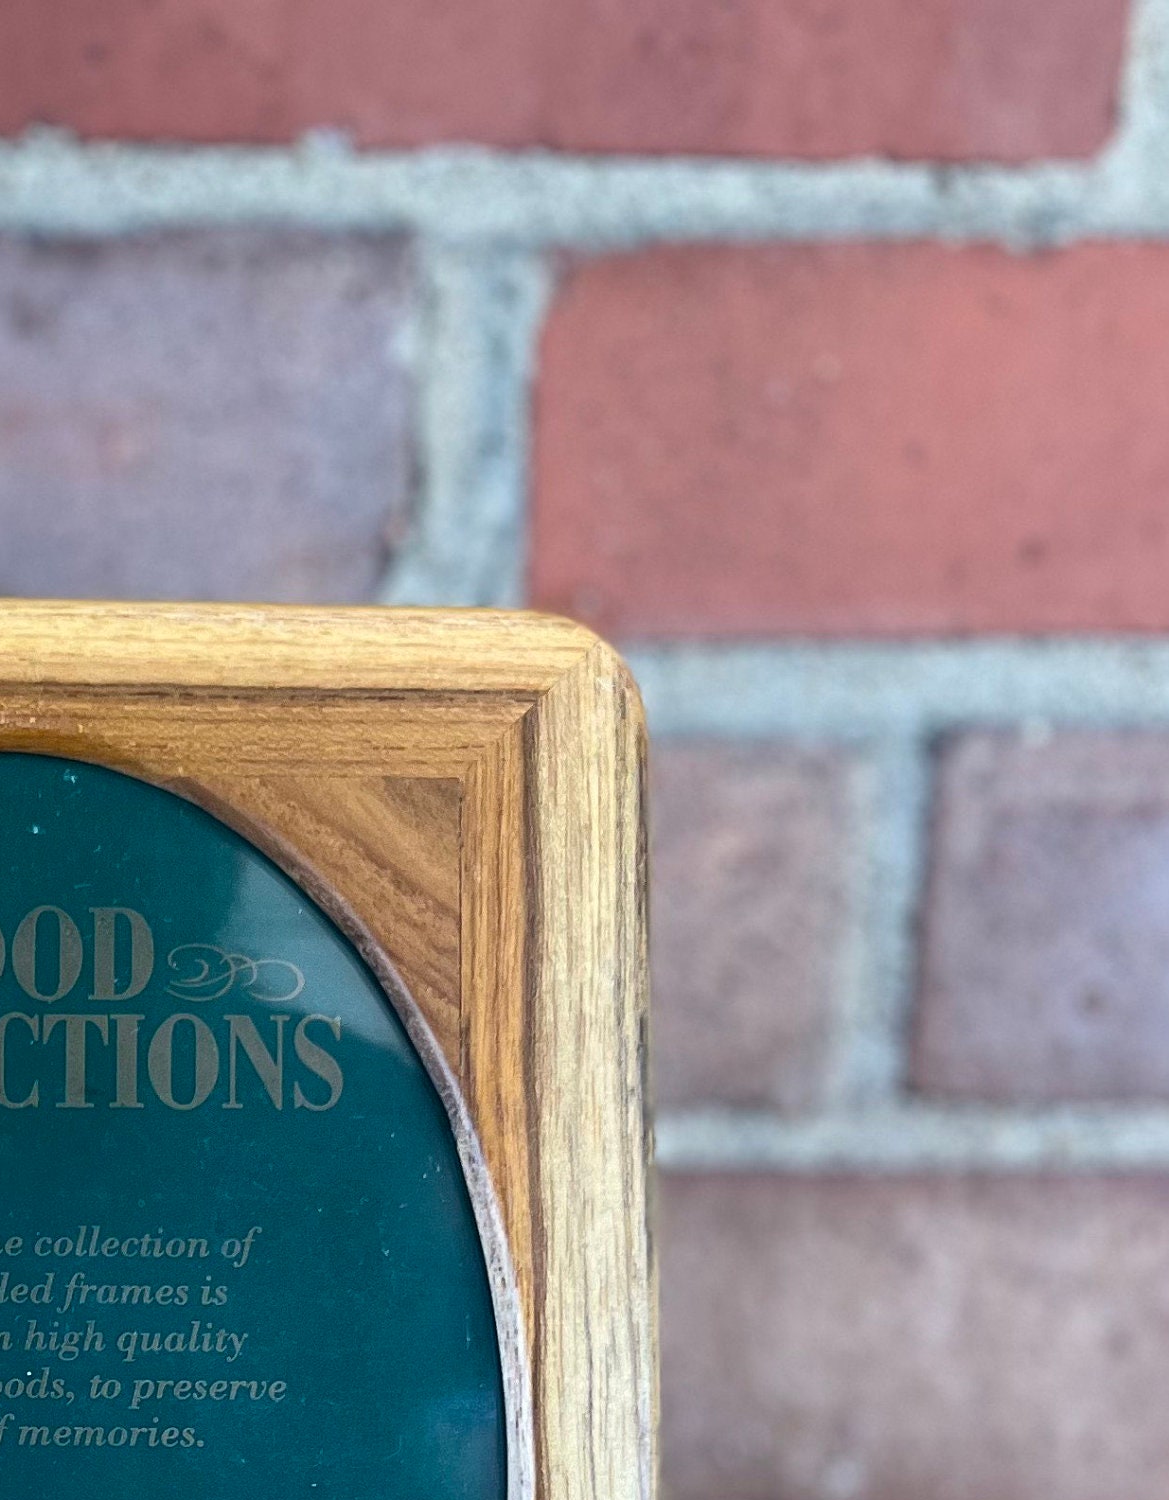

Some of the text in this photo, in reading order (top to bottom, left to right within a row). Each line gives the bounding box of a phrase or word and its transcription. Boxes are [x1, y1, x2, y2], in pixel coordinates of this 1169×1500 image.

[34, 1225, 210, 1258] collection
[220, 1226, 263, 1268] of
[56, 1272, 190, 1314] frames
[200, 1275, 229, 1305] is
[24, 1320, 106, 1362] high
[116, 1320, 249, 1363] quality
[89, 1374, 122, 1400] to
[128, 1379, 288, 1410] preserve
[18, 1416, 205, 1448] memories.
